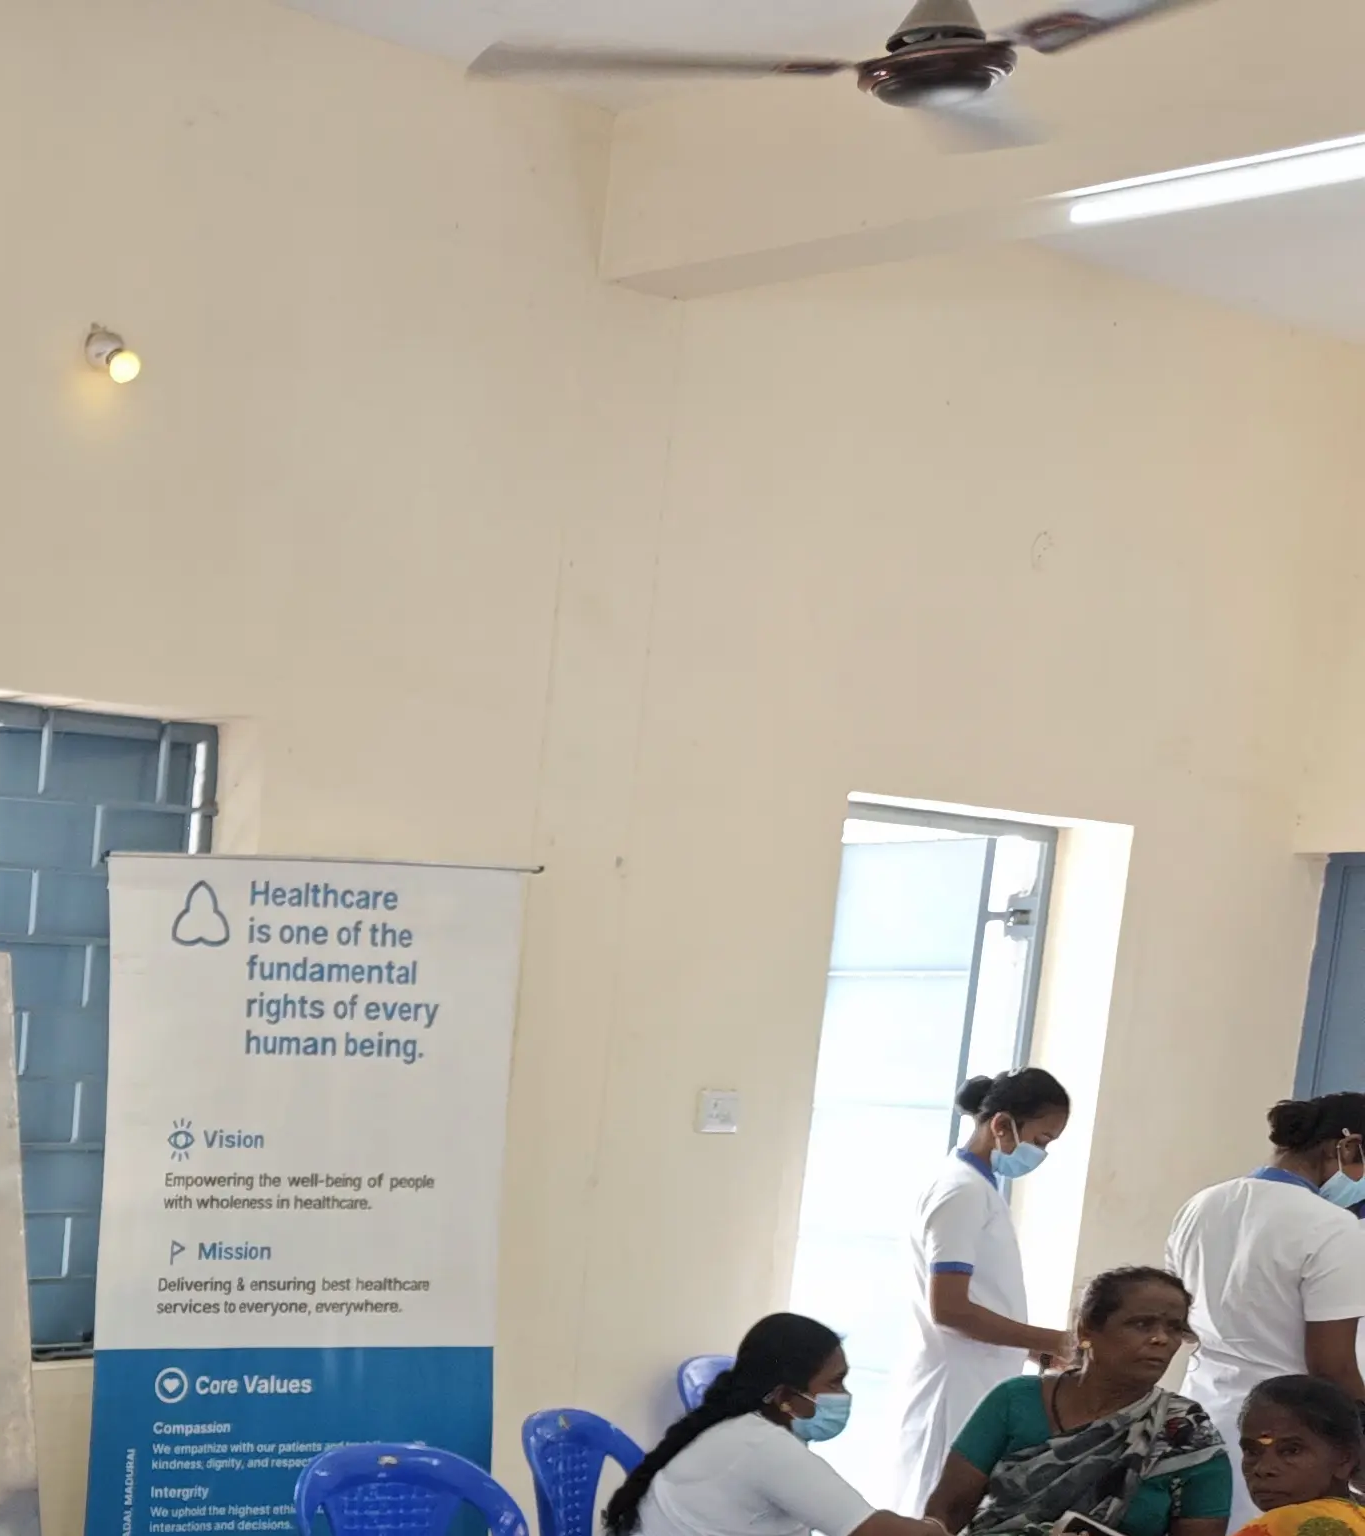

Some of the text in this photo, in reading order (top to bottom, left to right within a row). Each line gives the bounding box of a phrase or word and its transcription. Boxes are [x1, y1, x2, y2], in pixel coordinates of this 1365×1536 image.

[249, 880, 399, 911] Healthcare
[248, 917, 413, 949] is one of the
[245, 954, 418, 986] fundamental
[245, 992, 439, 1030] rights of every
[244, 1029, 424, 1066] human being.
[203, 1129, 265, 1150] Vision
[164, 1172, 435, 1192] Empowering the well-being of people
[163, 1193, 372, 1211] with wholeness in healthcare.
[197, 1241, 272, 1261] Mission
[157, 1276, 430, 1296] Delivering & ensuring best healthcare
[156, 1299, 403, 1317] services to everyone, everywhere.
[195, 1374, 313, 1395] Core Values
[152, 1421, 231, 1437] Compassion
[152, 1443, 172, 1456] We
[174, 1442, 228, 1457] empathize
[230, 1442, 255, 1454] with
[256, 1442, 276, 1454] our
[278, 1441, 322, 1456] patients
[151, 1458, 204, 1471] kindness,
[206, 1457, 244, 1471] dignity,
[246, 1457, 268, 1469] and
[123, 1448, 136, 1506] MADURAI
[150, 1505, 169, 1518] We
[171, 1505, 207, 1519] uphold
[208, 1504, 226, 1517] the
[228, 1503, 270, 1518] highest
[149, 1519, 294, 1533] interactions and decisions.
